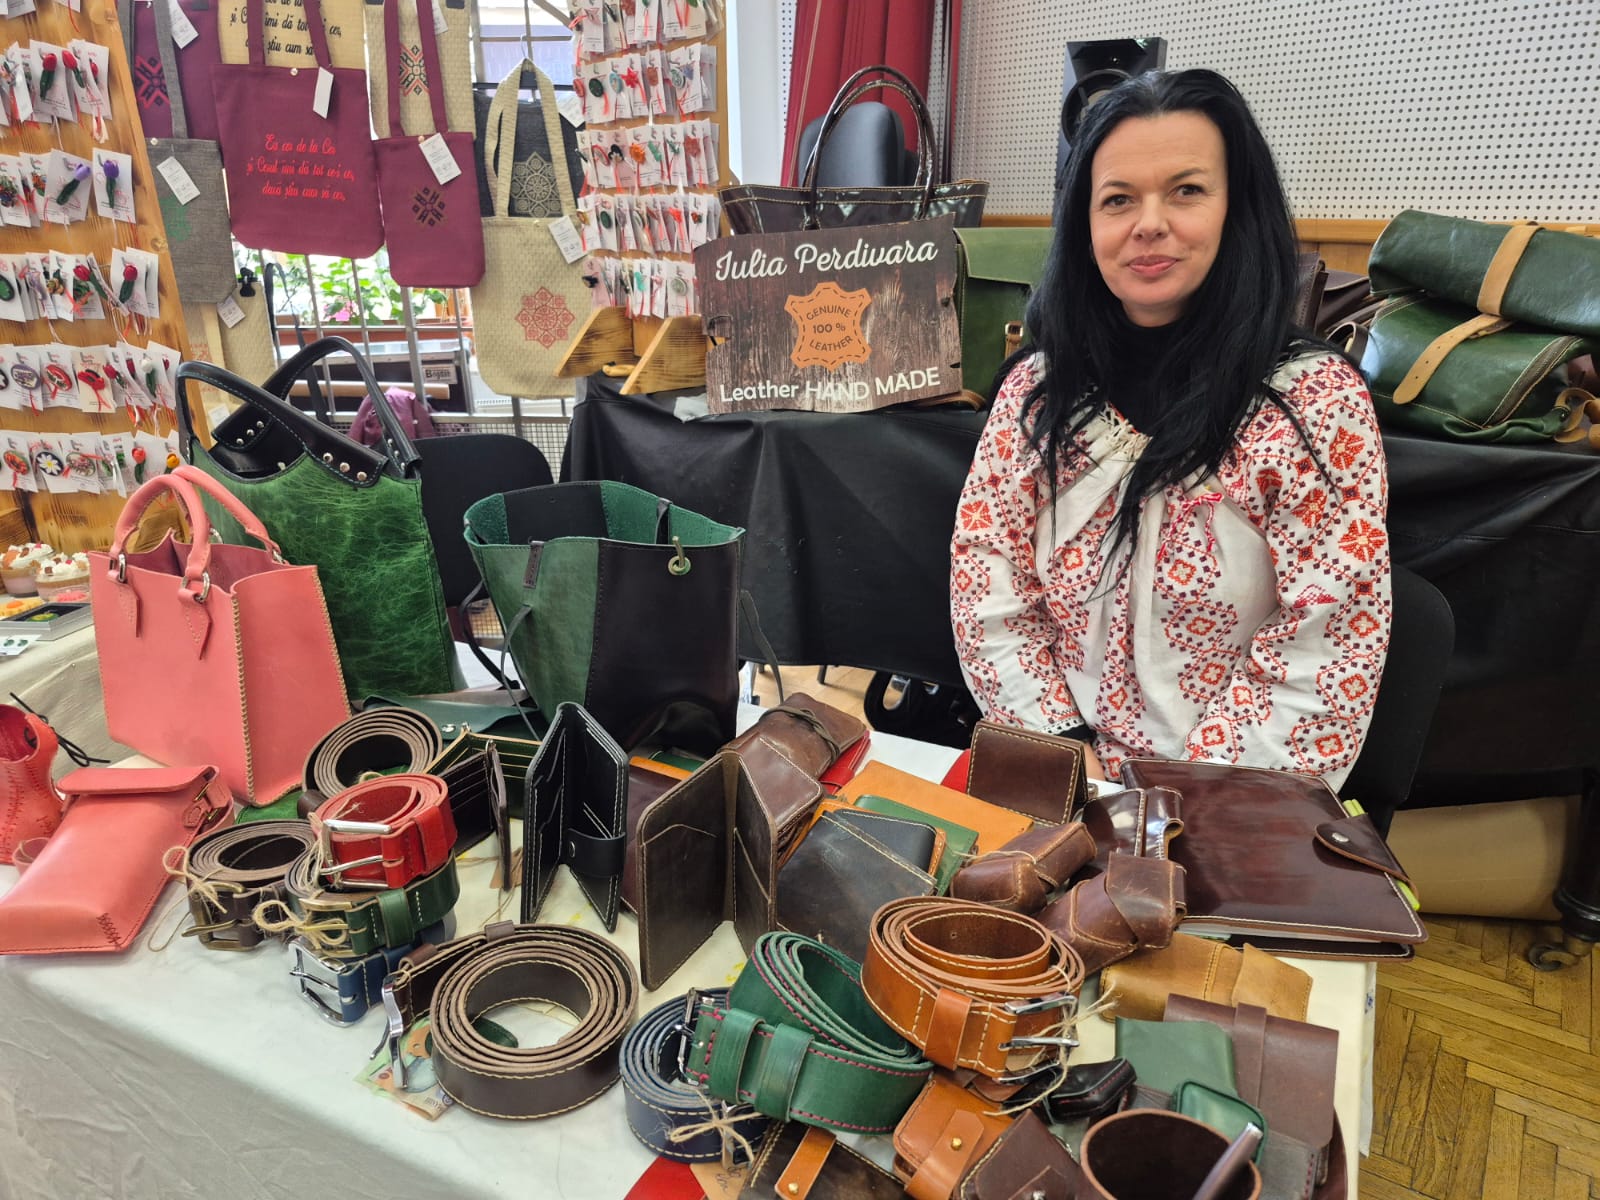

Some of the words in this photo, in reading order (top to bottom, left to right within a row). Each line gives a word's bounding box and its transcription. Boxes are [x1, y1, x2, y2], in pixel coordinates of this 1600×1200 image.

[794, 237, 938, 274] Perdivara
[806, 304, 852, 321] GENUINE
[812, 323, 833, 334] 100
[809, 335, 853, 352] LEATHER
[720, 380, 799, 402] Leather
[805, 380, 870, 401] HAND
[875, 366, 941, 396] MADE
